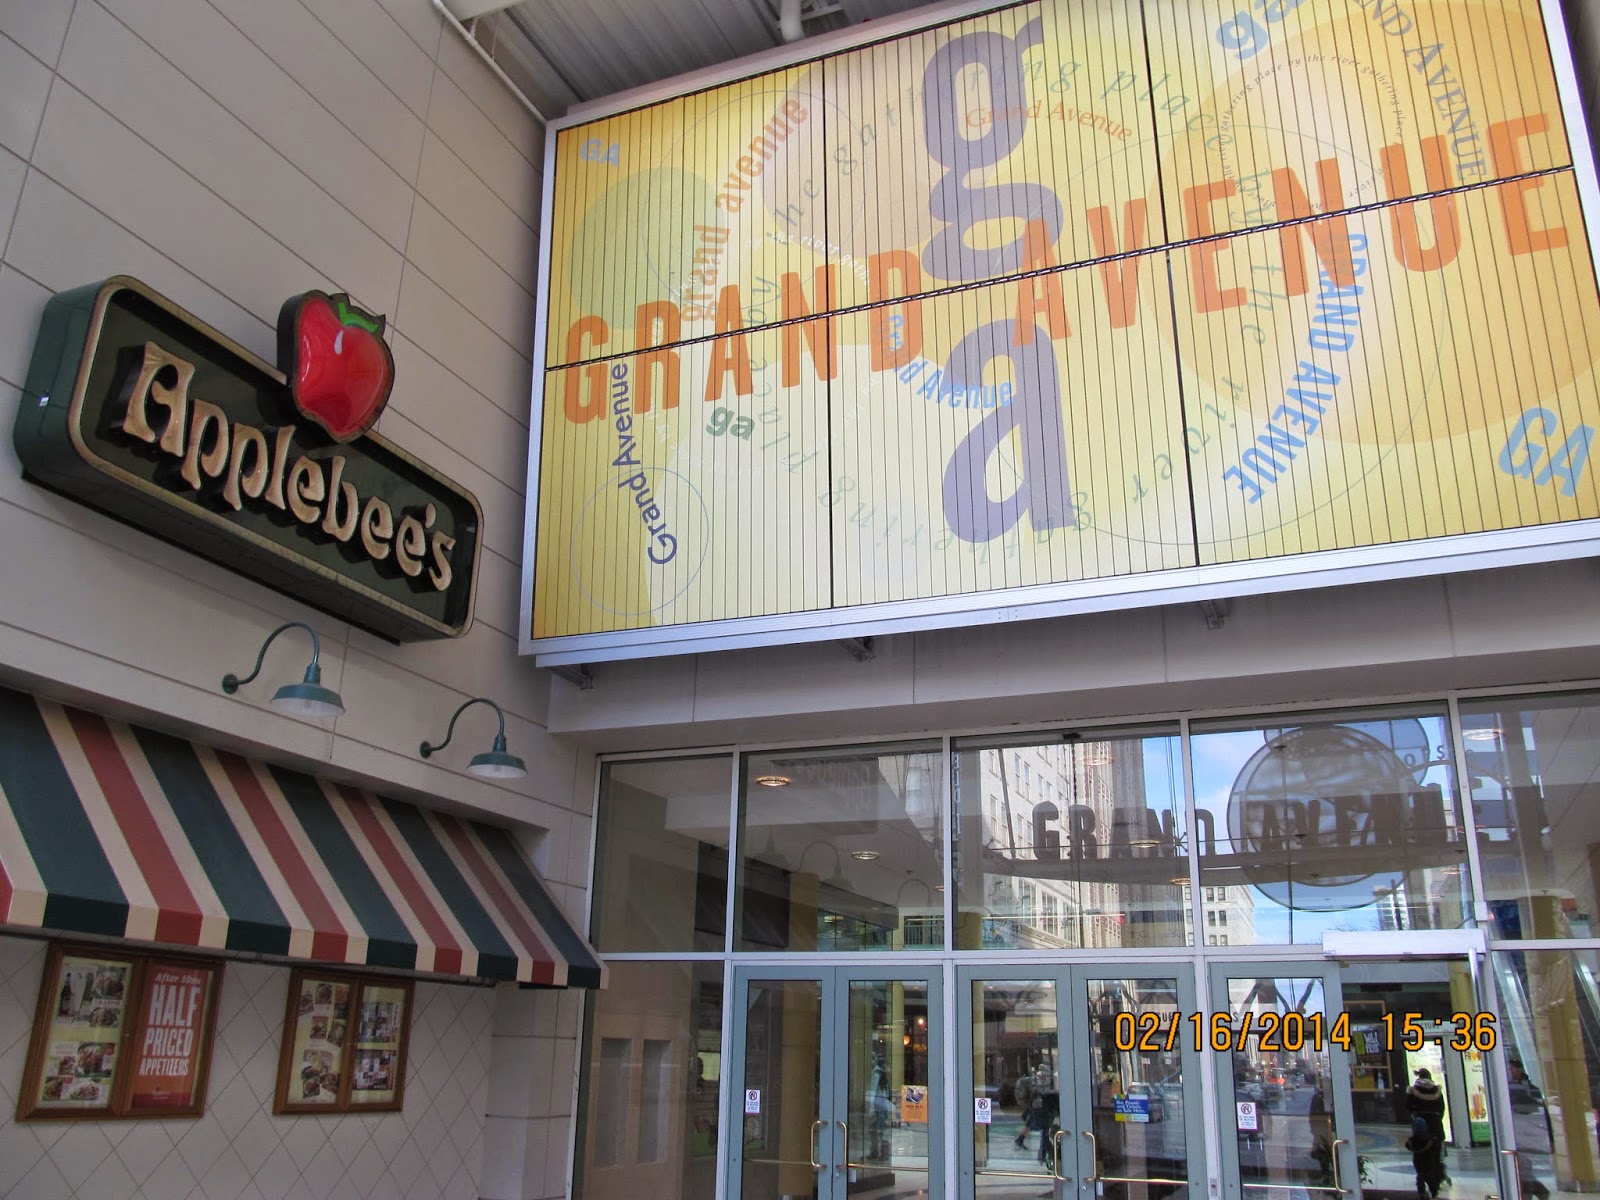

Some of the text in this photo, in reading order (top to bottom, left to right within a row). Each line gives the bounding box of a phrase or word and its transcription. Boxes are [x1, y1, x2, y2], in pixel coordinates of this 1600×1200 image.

[1307, 54, 1326, 62] the
[1046, 100, 1133, 142] Avenue
[1100, 62, 1234, 150] place
[1401, 42, 1487, 181] AVENUE
[579, 137, 621, 168] GA
[715, 99, 808, 213] avenue
[563, 112, 1570, 425] GRAND AVENUE
[1241, 263, 1287, 346] the
[612, 363, 642, 467] Avenue
[706, 405, 756, 441] ga
[916, 366, 1014, 410] Avenue
[122, 339, 457, 592] Applebee's
[1131, 375, 1245, 503] river
[1222, 361, 1342, 505] AVENUE
[1498, 406, 1595, 498] GA
[618, 471, 678, 565] Grand
[1032, 801, 1216, 860] GRAND
[142, 1027, 194, 1057] PRICED
[148, 984, 201, 1027] HALF
[139, 1058, 190, 1076] APPETIZERS
